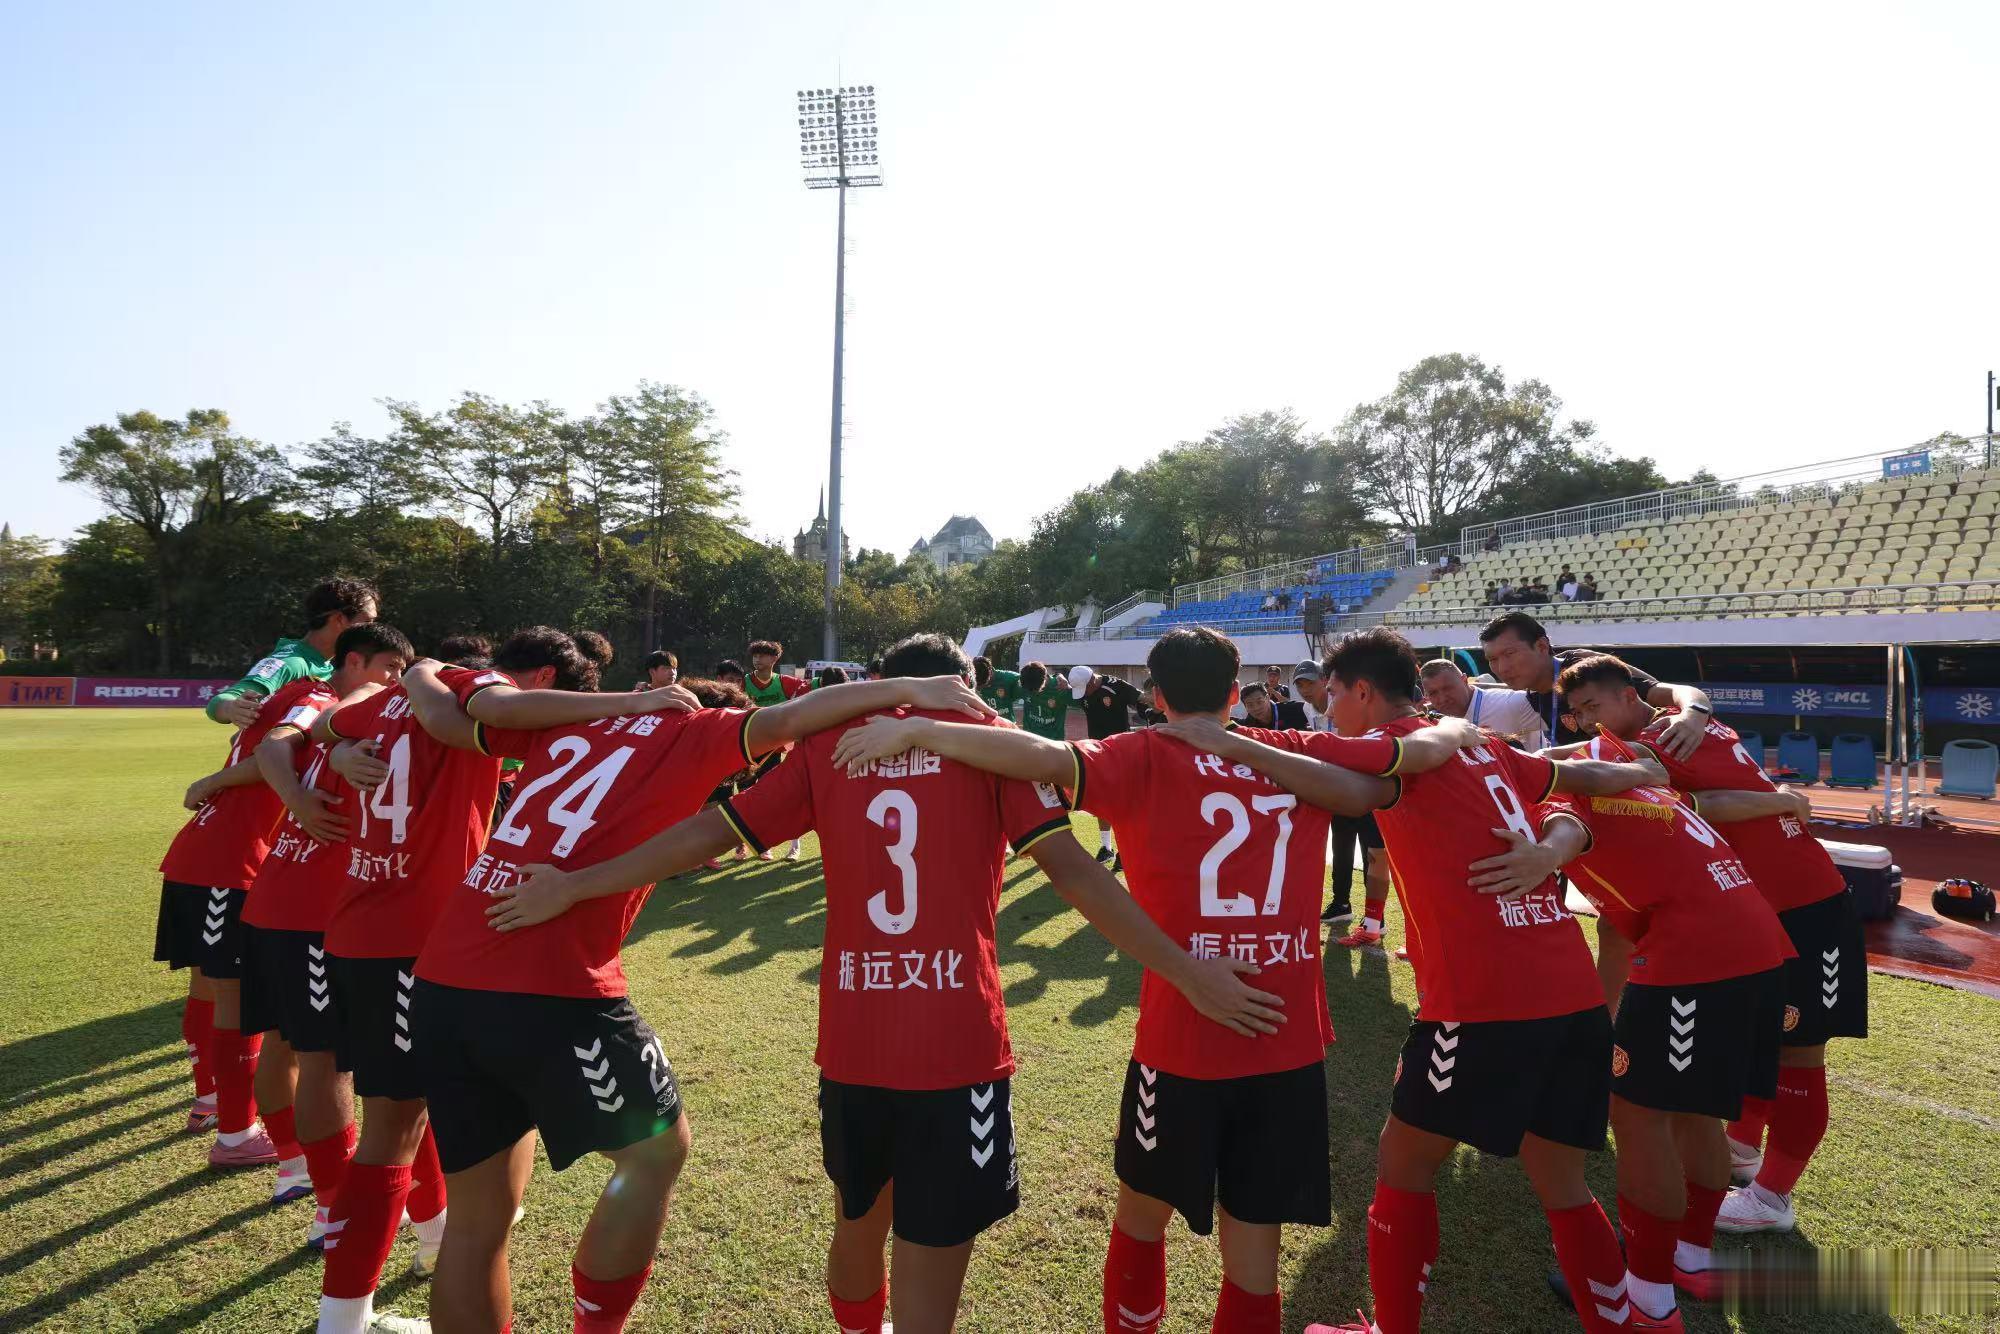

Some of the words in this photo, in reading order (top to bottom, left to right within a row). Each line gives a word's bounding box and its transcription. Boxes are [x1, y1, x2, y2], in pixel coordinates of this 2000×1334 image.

[94, 686, 181, 698] RESPECT
[1825, 692, 1870, 703] CMCL
[360, 733, 413, 844] 14
[491, 735, 636, 859] 24
[347, 847, 411, 882] 振远文化
[462, 852, 524, 893] 振远
[866, 790, 918, 935] 3
[1200, 792, 1297, 917] 27
[1189, 925, 1314, 967] 振远文化
[839, 949, 964, 991] 振远文化
